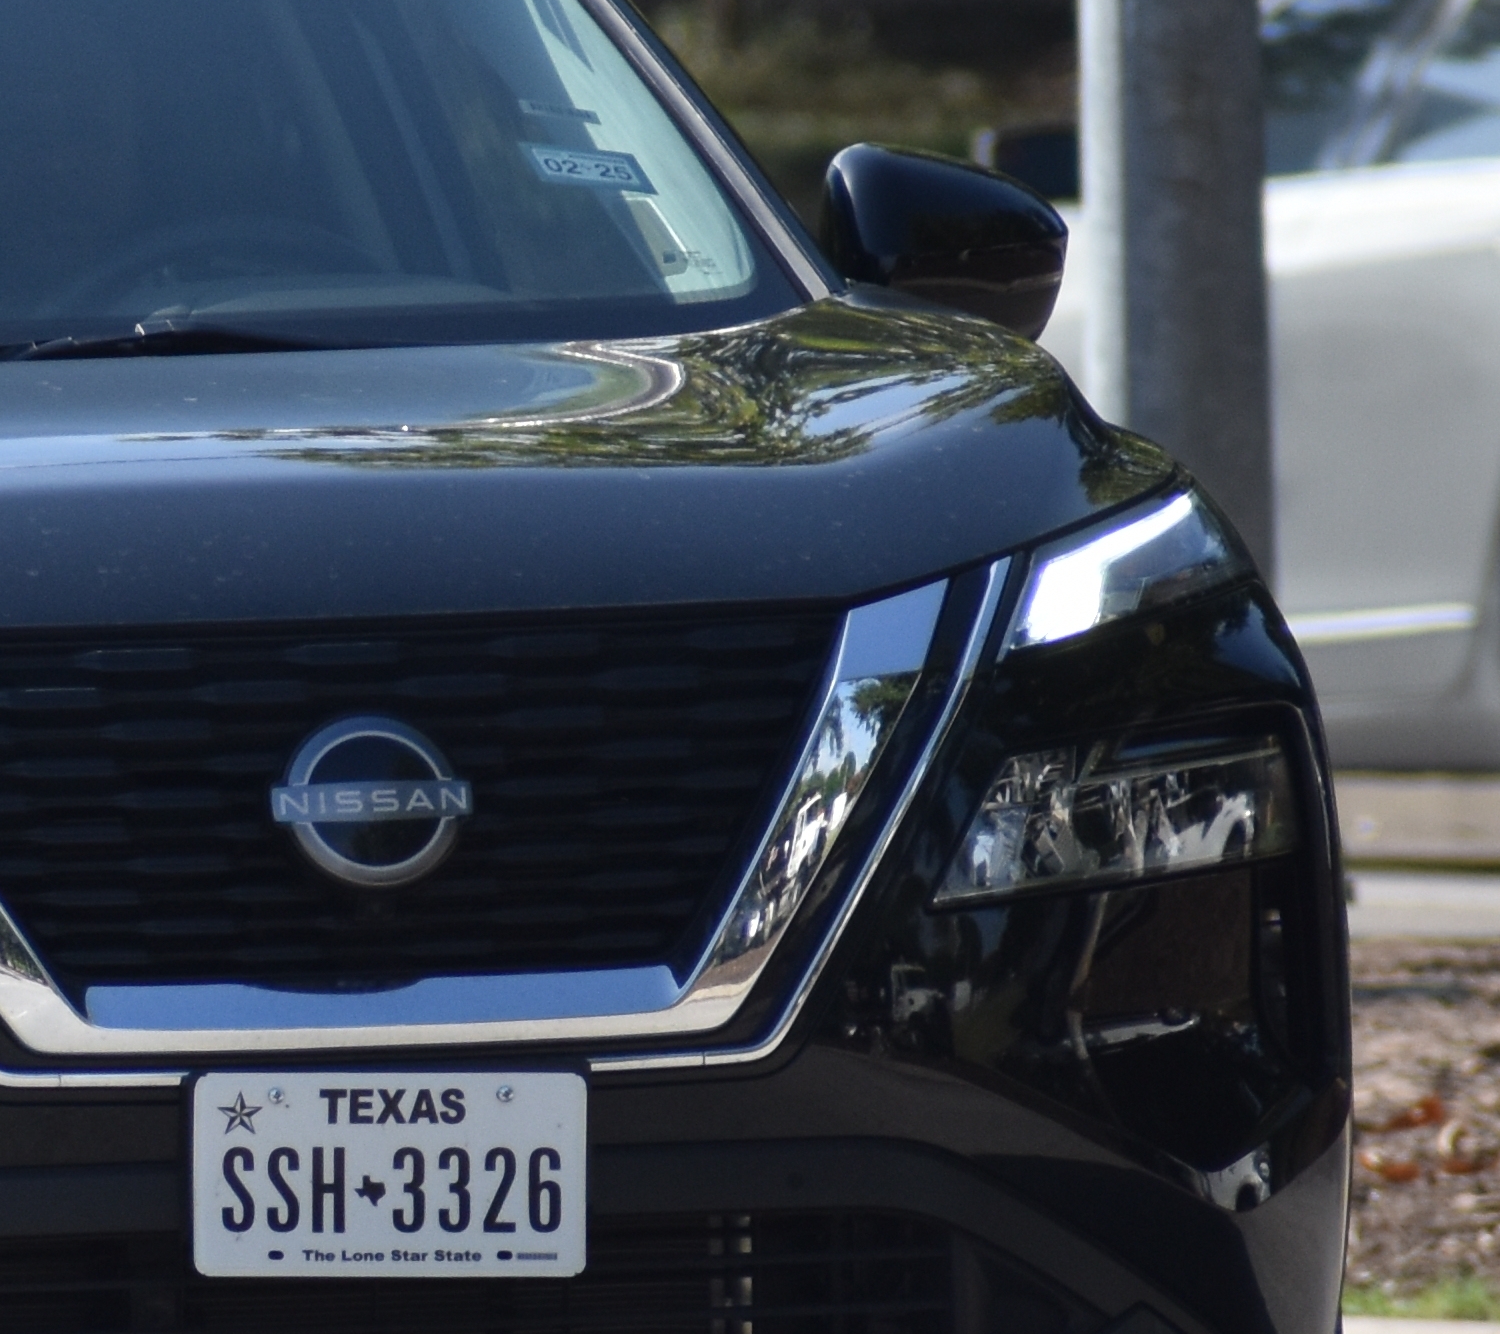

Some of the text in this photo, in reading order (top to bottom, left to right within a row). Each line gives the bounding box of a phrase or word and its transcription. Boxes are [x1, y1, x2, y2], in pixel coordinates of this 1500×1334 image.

[279, 786, 467, 816] NISSAN
[319, 1088, 467, 1125] TEXAS
[302, 1249, 482, 1262] The Lone Star State
